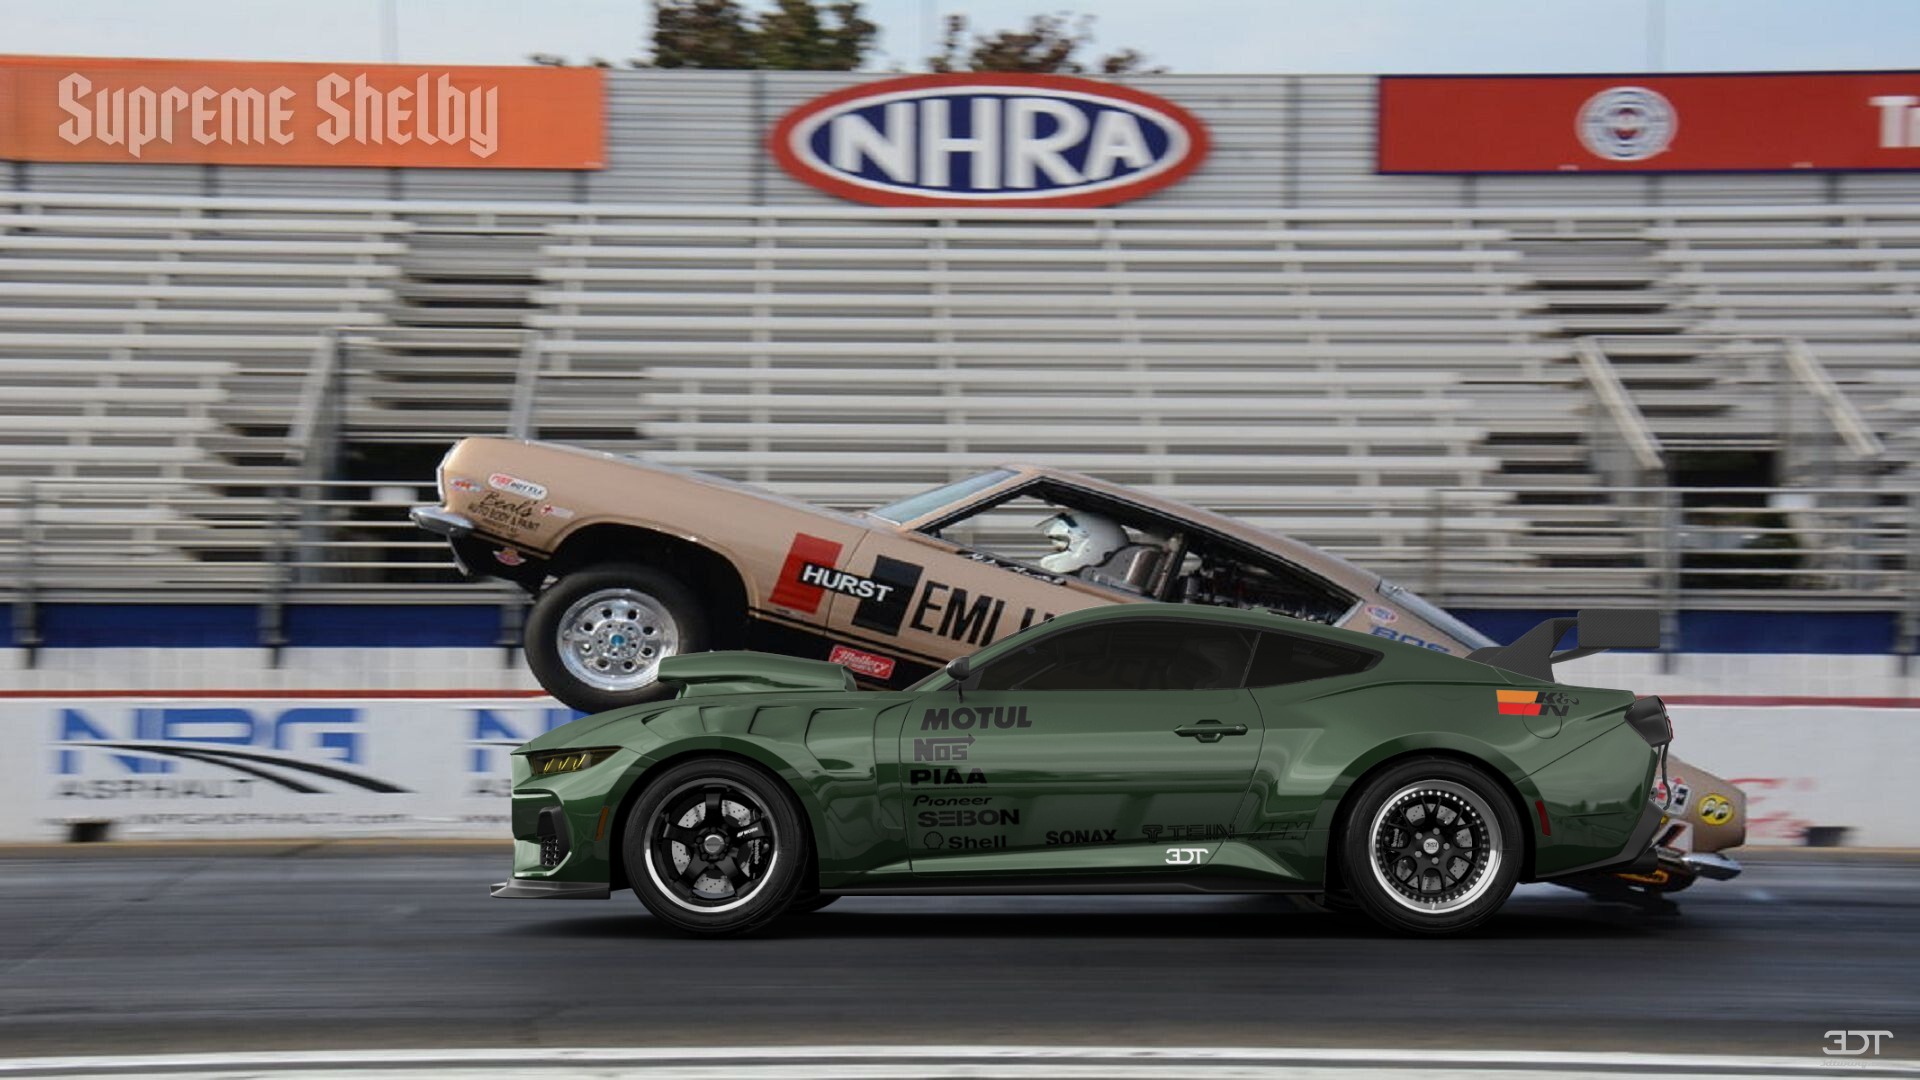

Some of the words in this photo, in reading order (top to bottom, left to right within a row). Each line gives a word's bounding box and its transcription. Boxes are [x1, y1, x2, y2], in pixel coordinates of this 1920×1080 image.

[829, 97, 1155, 189] NHRA
[802, 564, 894, 602] HURST
[920, 706, 1033, 731] MOTUL
[913, 736, 976, 762] NOS
[910, 767, 988, 786] PIAA
[912, 794, 993, 807] Pioneer
[917, 808, 1020, 828] SEBON
[1045, 829, 1118, 846] SONAX
[1167, 823, 1236, 841] TEIN
[948, 835, 1007, 850] Shell
